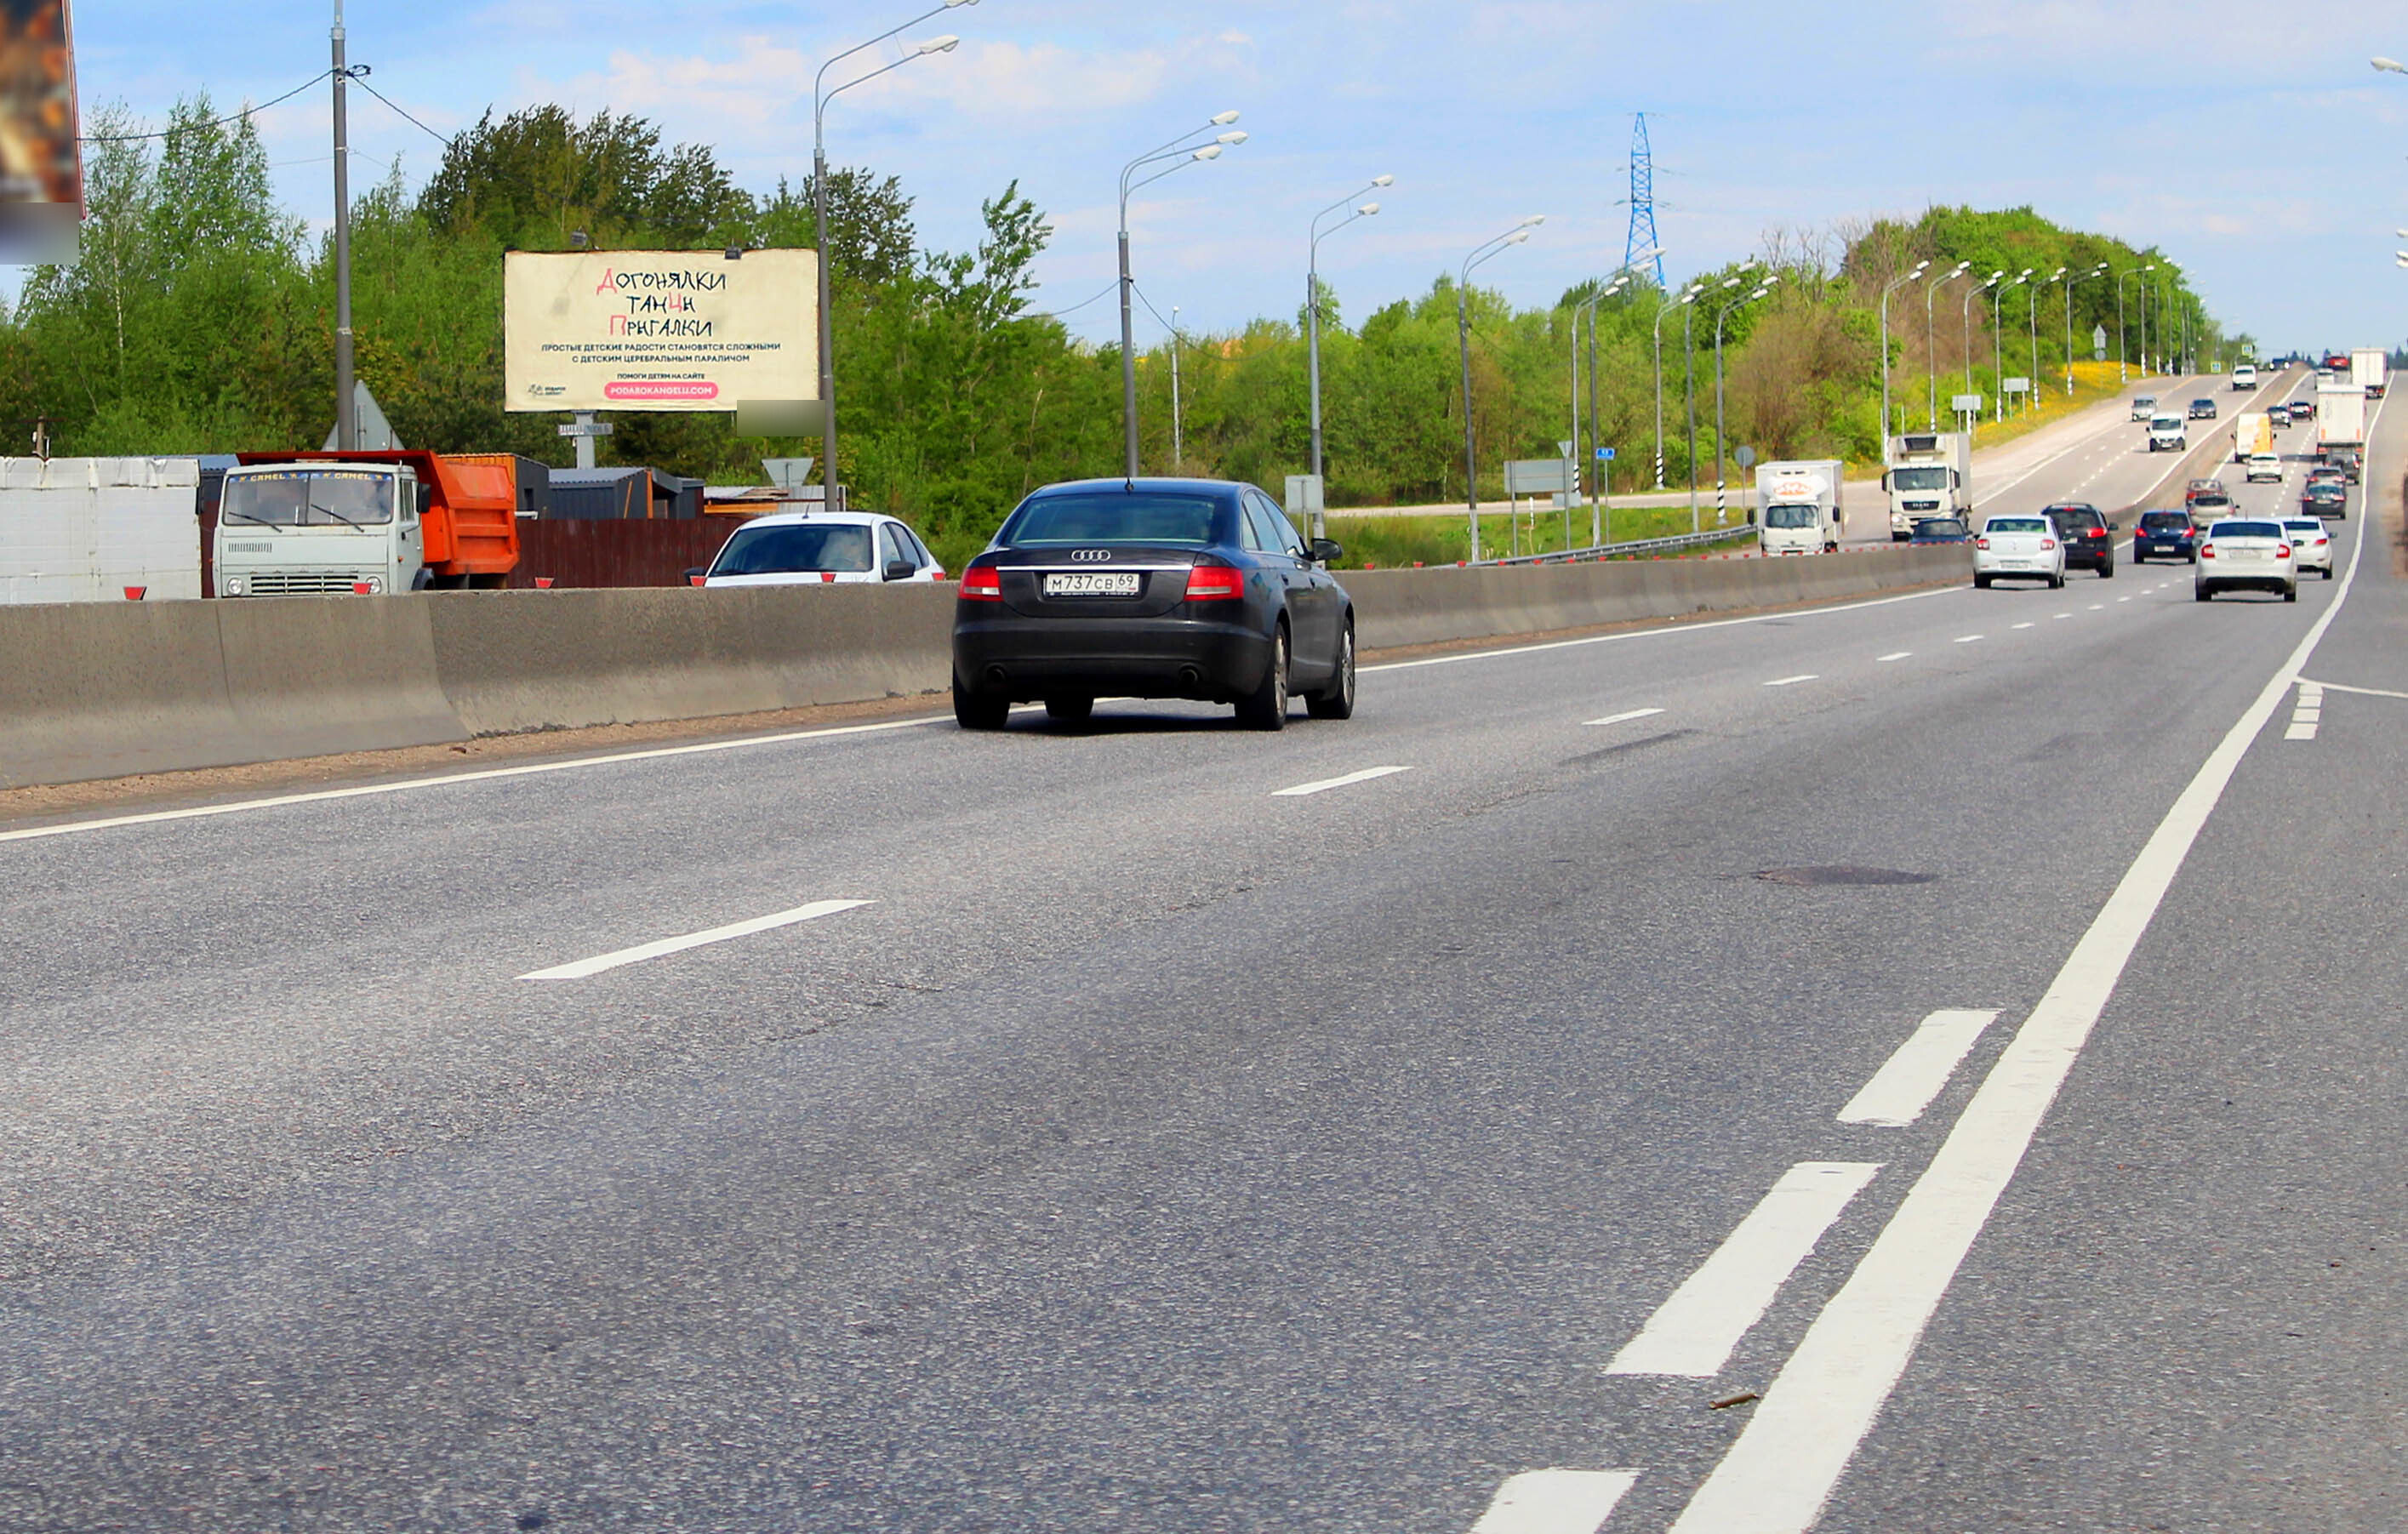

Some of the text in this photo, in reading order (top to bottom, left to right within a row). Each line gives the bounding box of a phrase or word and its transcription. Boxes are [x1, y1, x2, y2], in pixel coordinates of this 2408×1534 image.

[541, 344, 582, 352] ПРОСТЫЕ
[584, 344, 623, 352] ДЕТСКИЕ
[625, 344, 666, 352] РАДОСТИ
[667, 343, 724, 351] СТАНОВЯТСЯ
[580, 356, 622, 364] ДЕТСКИМ
[624, 355, 693, 363] ЦЕРЕБРАЛЬНЫМ
[250, 473, 286, 482] CAMEL
[334, 472, 372, 481] CAMEL
